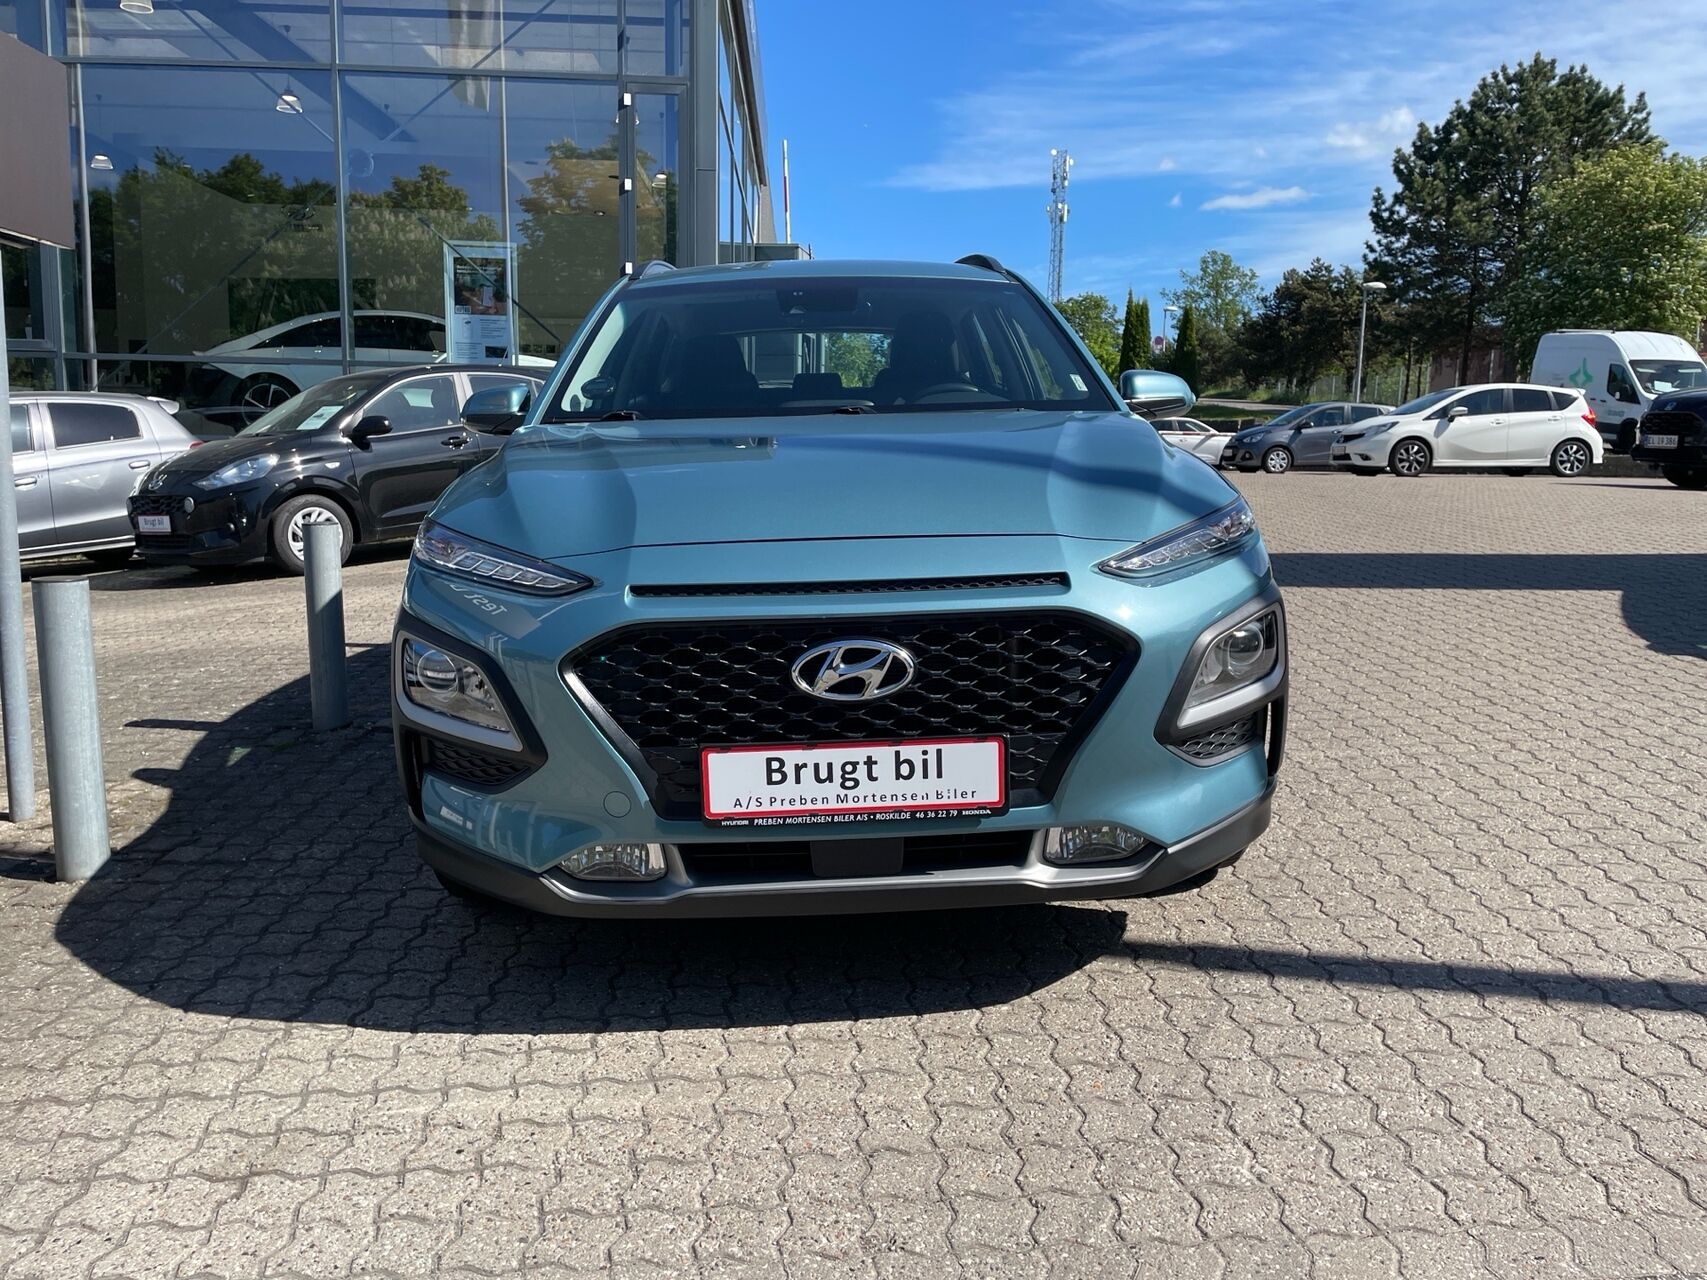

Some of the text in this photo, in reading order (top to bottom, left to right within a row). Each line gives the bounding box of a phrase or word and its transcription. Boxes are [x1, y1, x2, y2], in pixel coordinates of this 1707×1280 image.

[765, 748, 943, 790] Brugt bil
[733, 788, 977, 810] A/S Preben Mortensen Biler
[753, 817, 784, 826] PREBEN
[785, 814, 832, 825] MORTENSEN
[833, 813, 856, 822] BILER
[875, 811, 911, 820] ROSKILDE
[915, 811, 924, 819] 46
[926, 810, 936, 818] 36
[937, 809, 947, 818] 22
[949, 809, 958, 817] 79
[962, 808, 992, 816] HONDA
